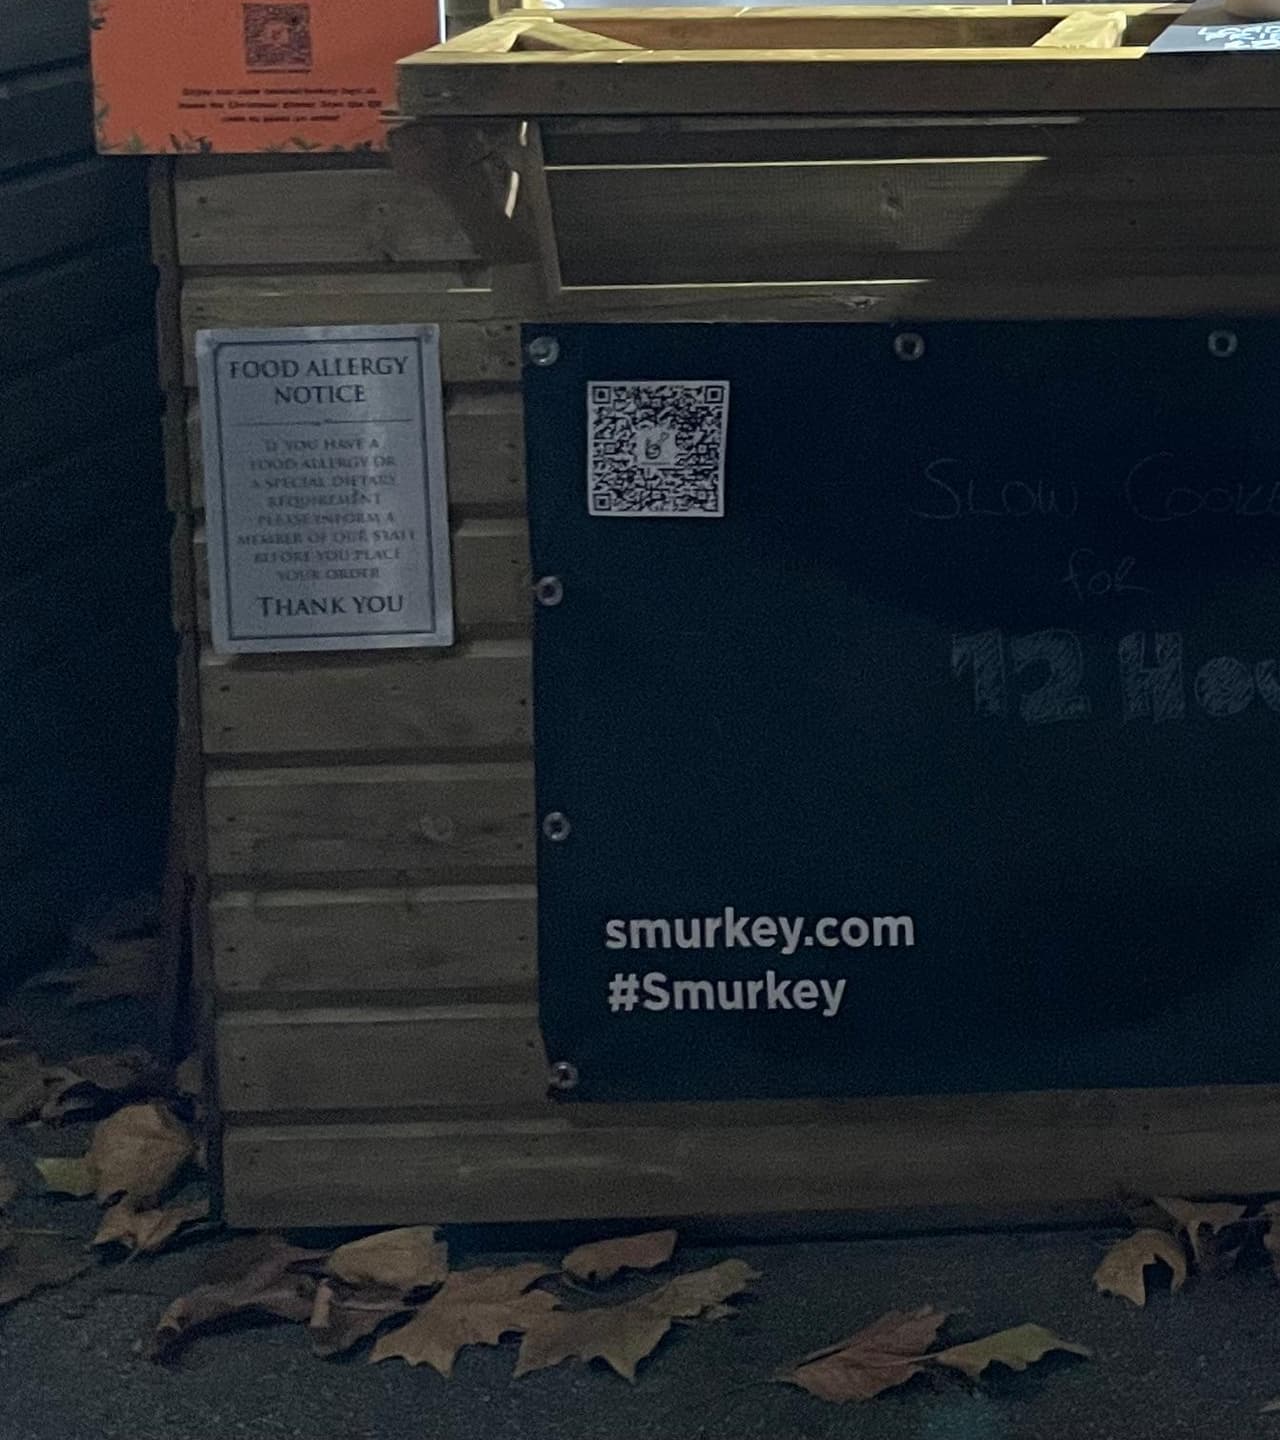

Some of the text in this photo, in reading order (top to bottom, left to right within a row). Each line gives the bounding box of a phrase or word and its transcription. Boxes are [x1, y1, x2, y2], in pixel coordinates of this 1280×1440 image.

[229, 356, 408, 380] FOOD ALLERGY
[274, 384, 367, 405] NOTICE
[257, 594, 404, 618] THANK YOU
[951, 626, 1092, 725] 12
[605, 906, 916, 954] smurkey.com
[608, 972, 848, 1017] #Smurkey
